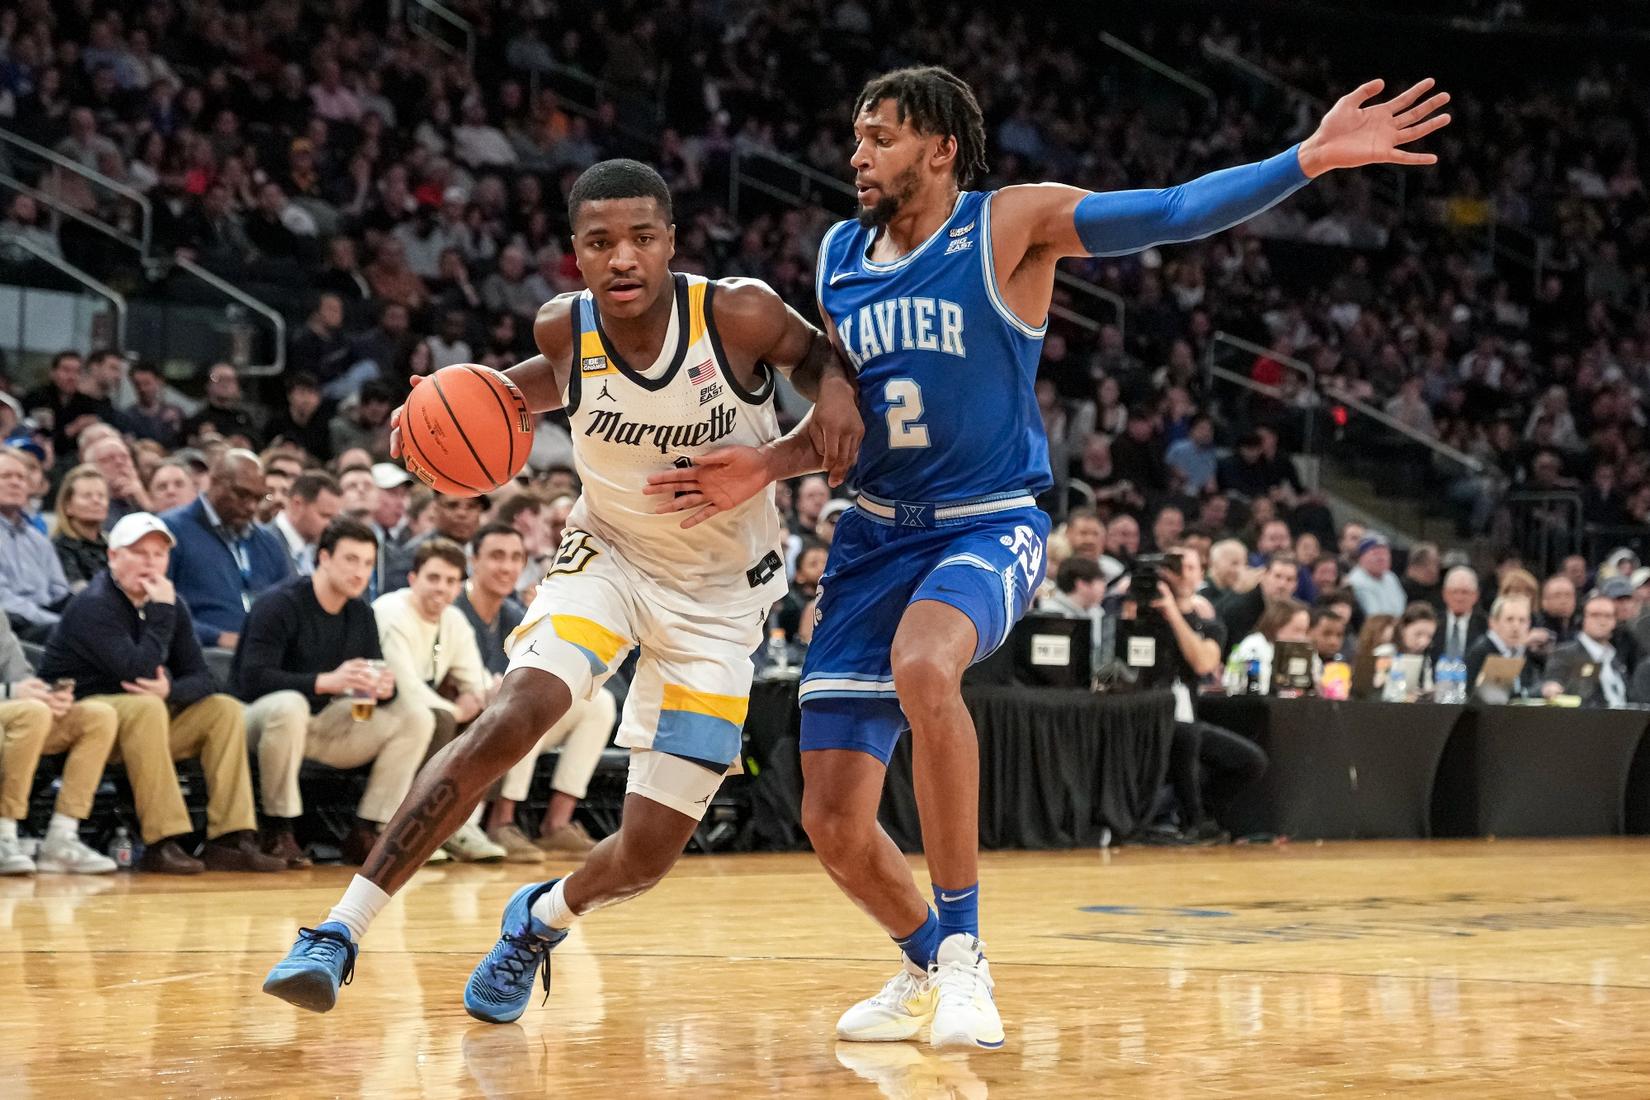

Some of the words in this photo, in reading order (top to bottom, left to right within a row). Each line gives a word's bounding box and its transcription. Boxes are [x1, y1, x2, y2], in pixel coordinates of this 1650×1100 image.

[700, 382, 717, 396] BIG
[700, 385, 724, 403] EAST
[585, 402, 737, 455] Marquette
[883, 377, 932, 450] 2
